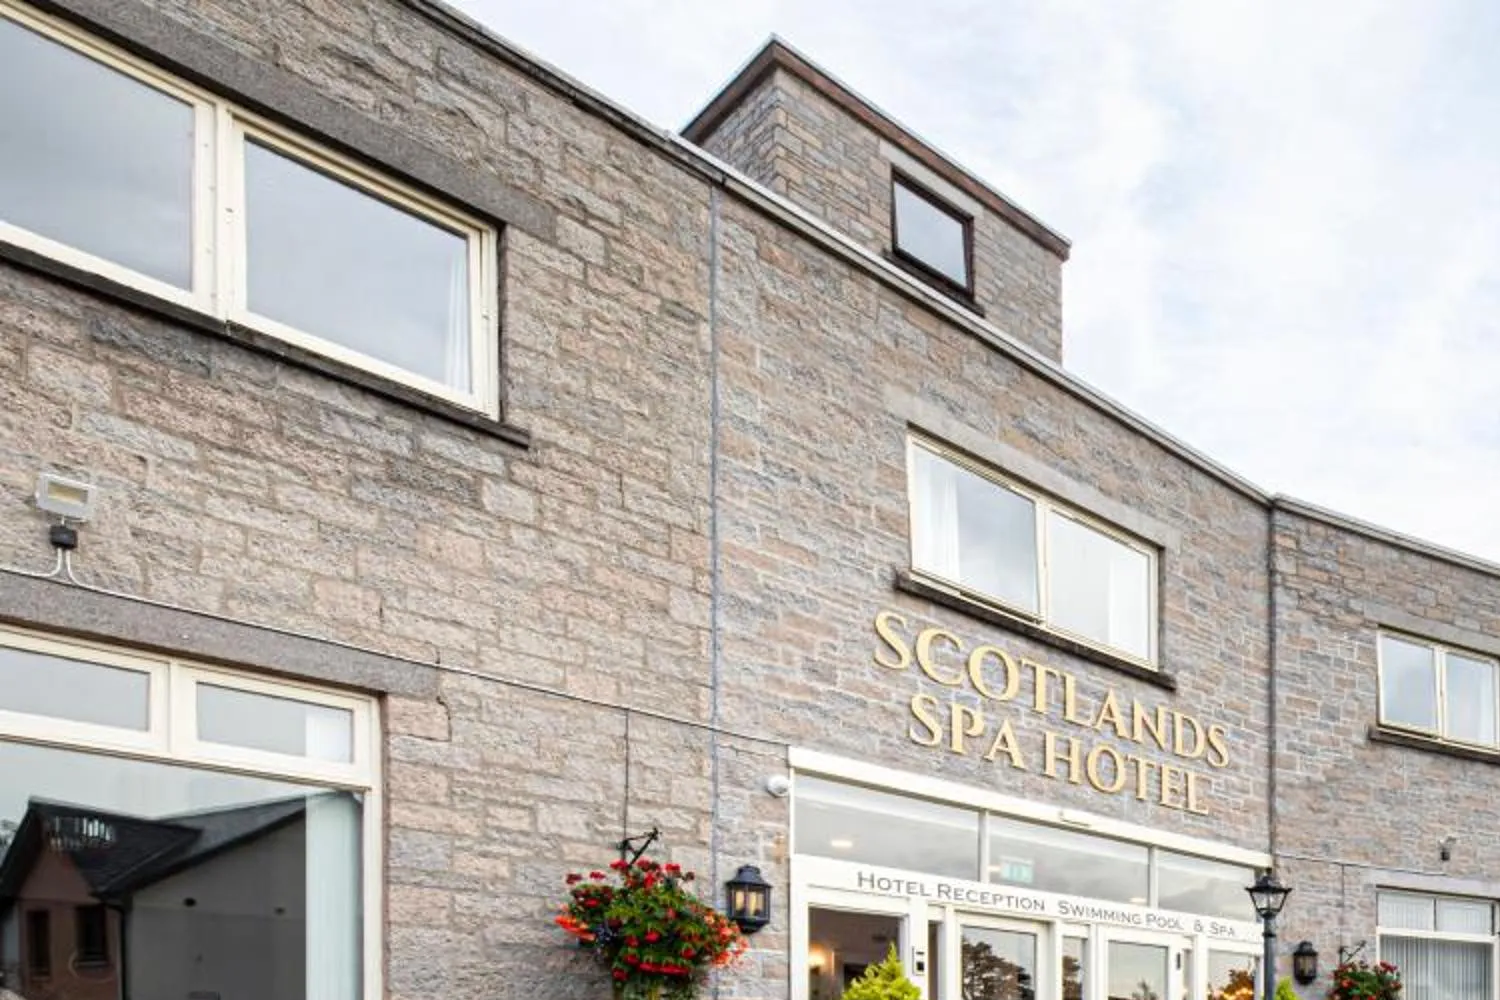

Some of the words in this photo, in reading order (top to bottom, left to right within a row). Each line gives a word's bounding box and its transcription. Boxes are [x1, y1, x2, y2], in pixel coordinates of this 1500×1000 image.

[873, 609, 1230, 768] SCOTLANDS
[909, 693, 1027, 770] SPA
[1043, 730, 1210, 816] HOTEL
[857, 871, 932, 897] HOTEL
[937, 883, 1045, 911] RECEPTION
[1057, 900, 1141, 926] SWIMMING
[1193, 919, 1203, 933] &
